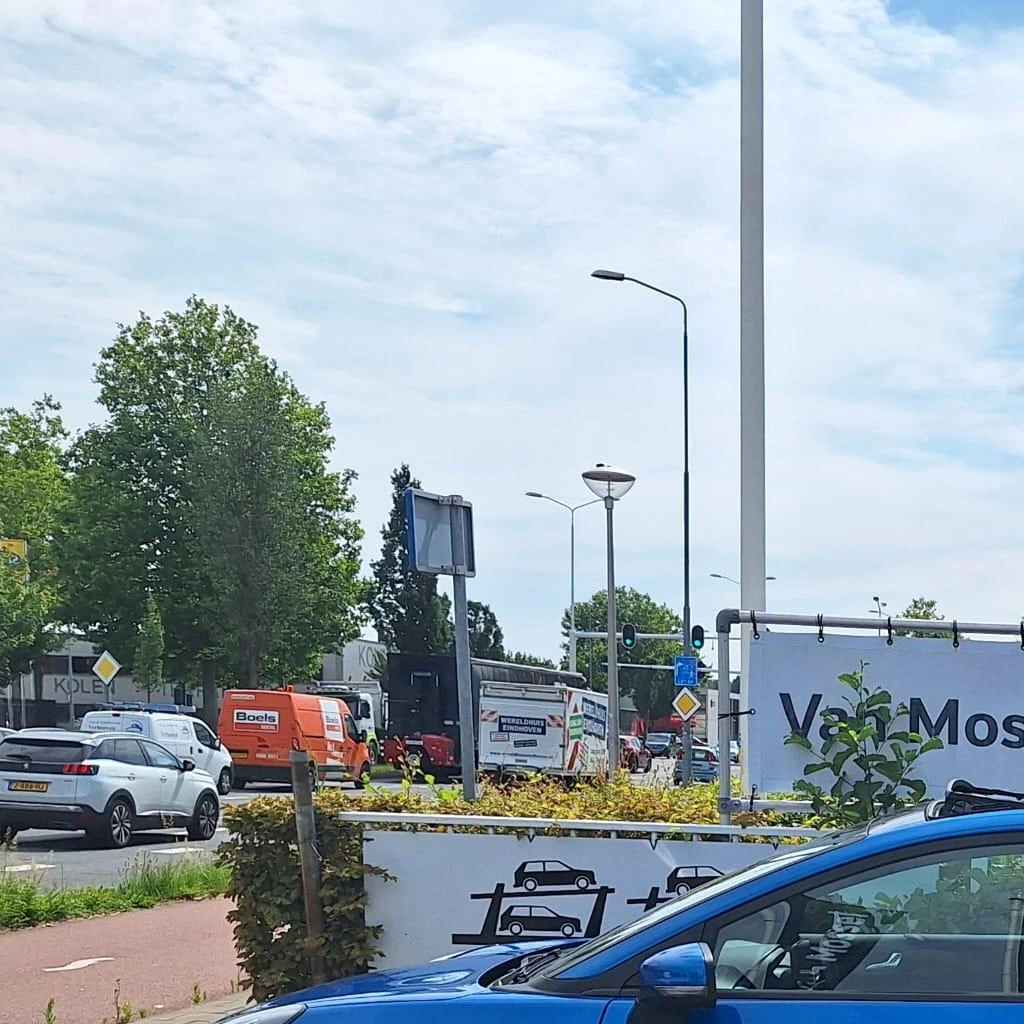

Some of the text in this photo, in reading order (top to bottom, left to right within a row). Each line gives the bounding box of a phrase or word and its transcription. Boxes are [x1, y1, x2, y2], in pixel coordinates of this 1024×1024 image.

[236, 711, 276, 723] Boels
[500, 717, 545, 726] WERELDHUIS
[779, 692, 886, 743] Van
[502, 725, 542, 734] EINDHOVEN
